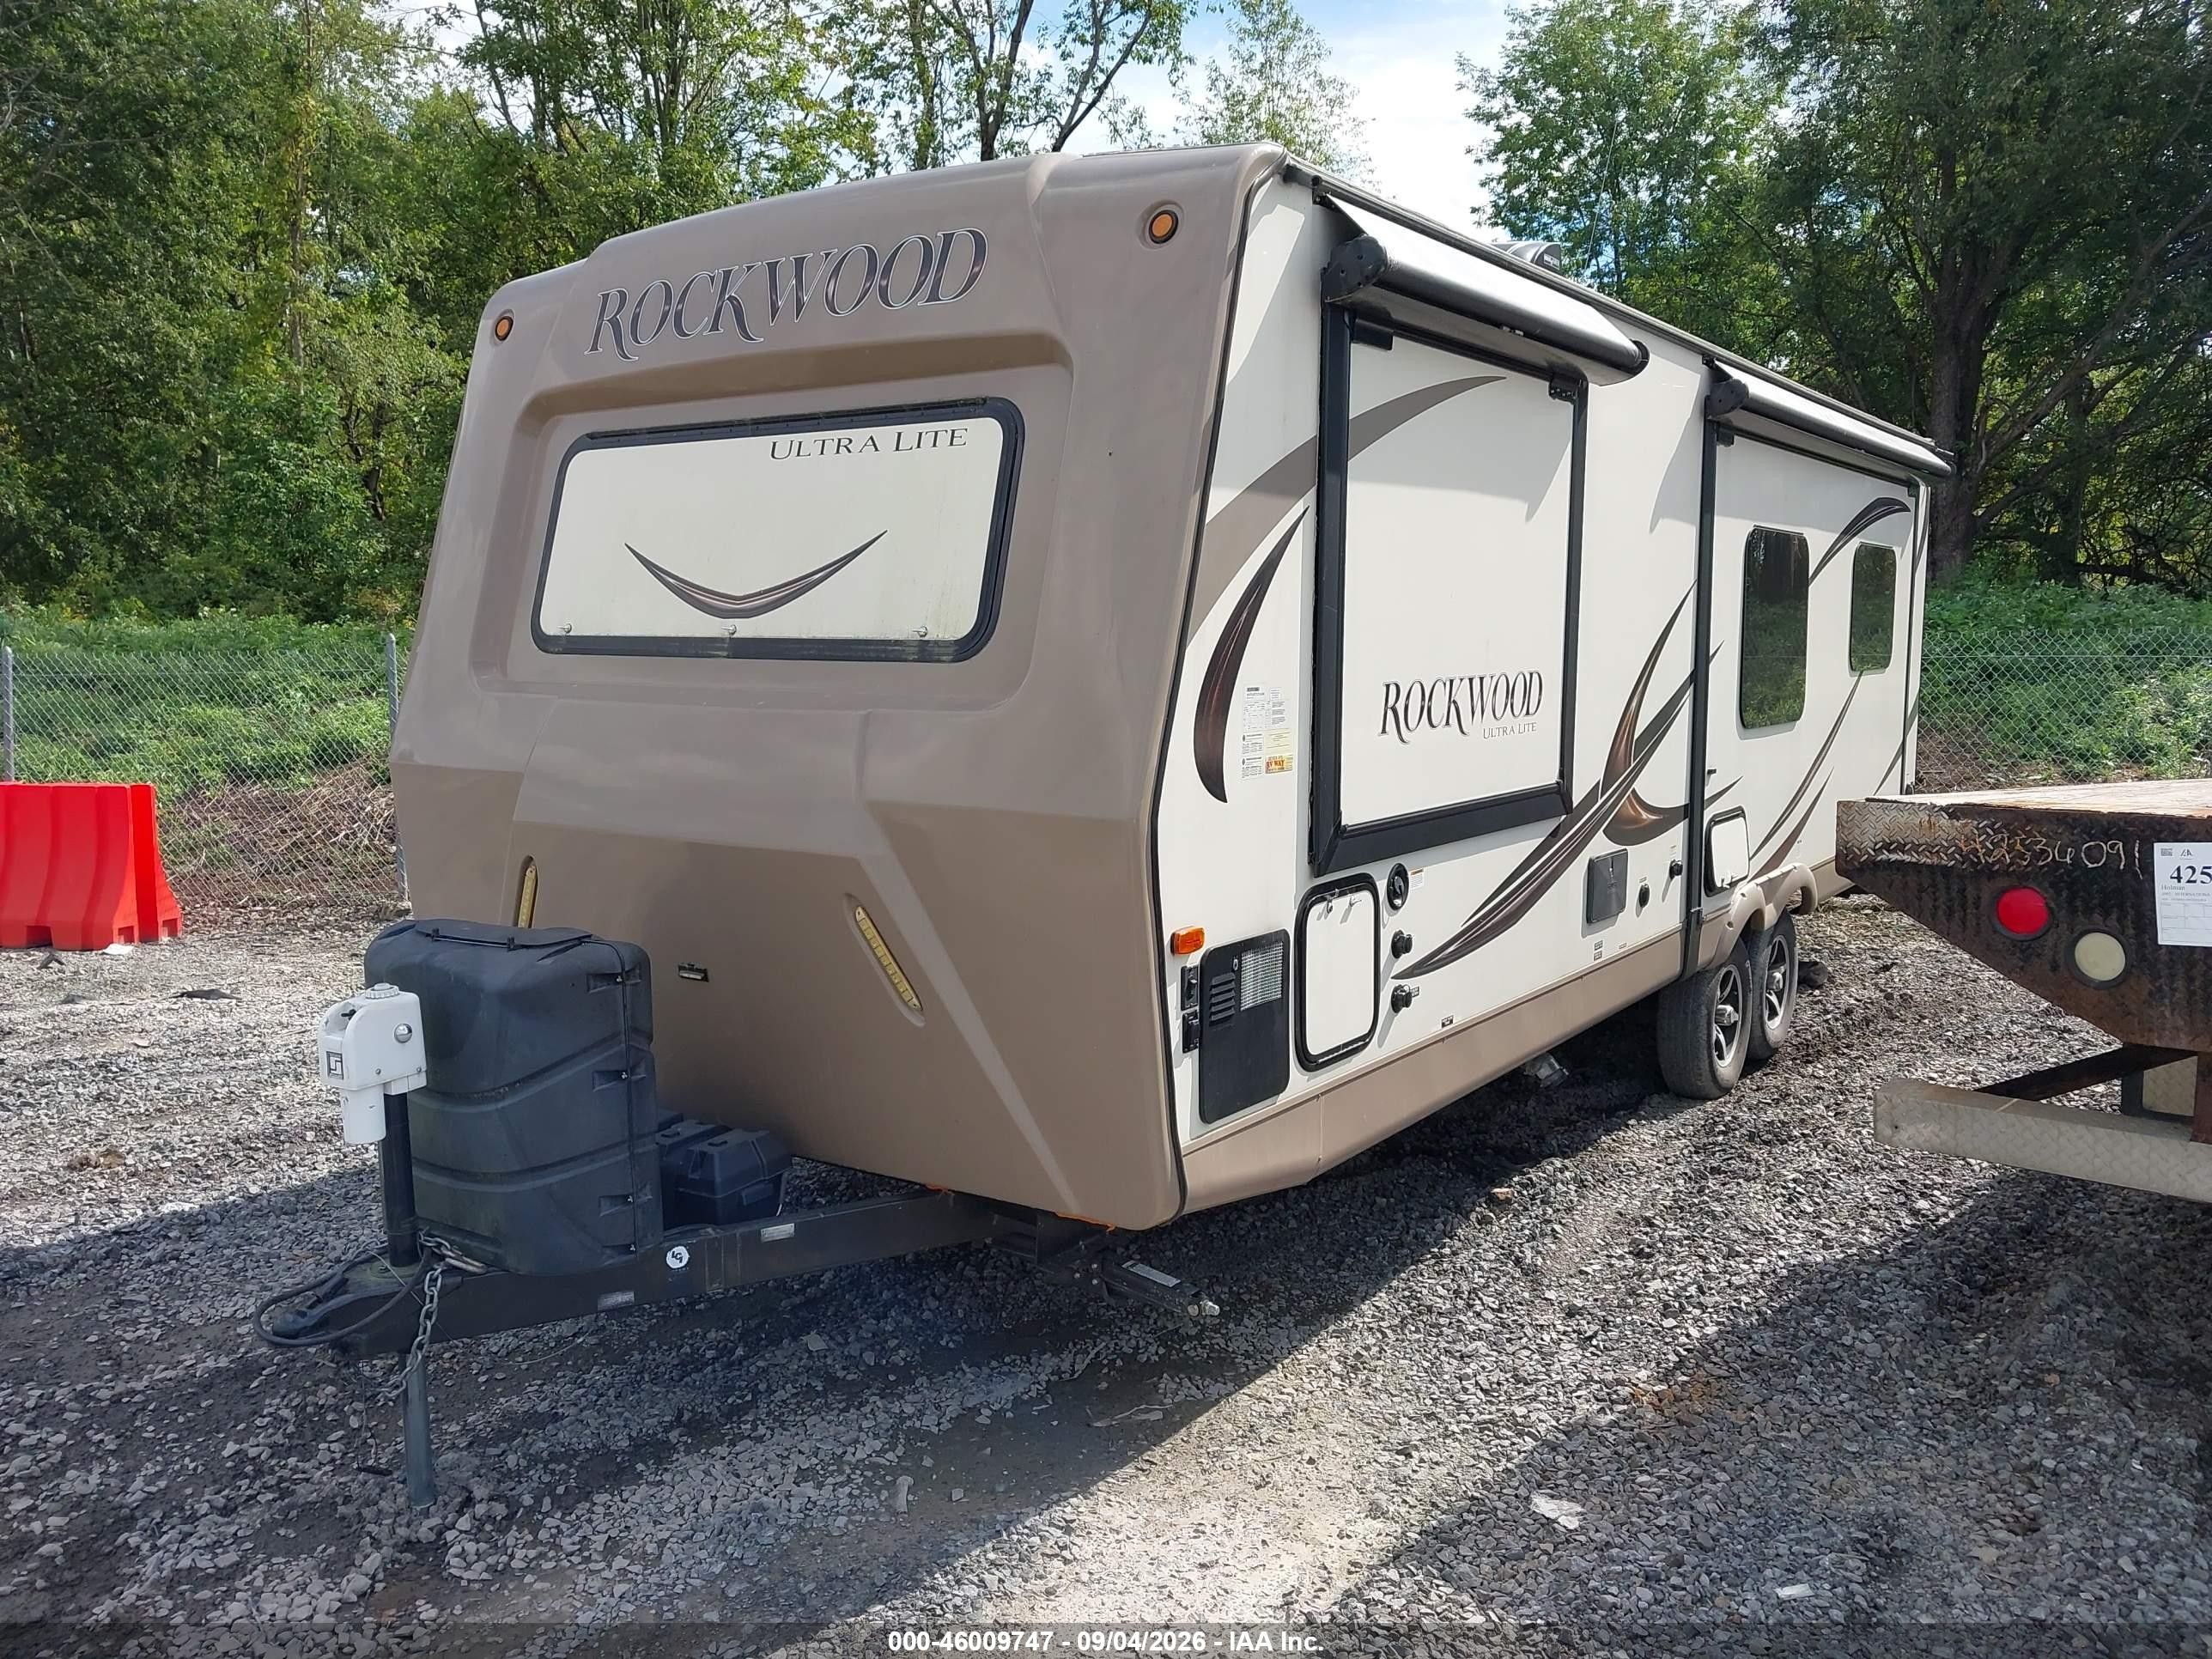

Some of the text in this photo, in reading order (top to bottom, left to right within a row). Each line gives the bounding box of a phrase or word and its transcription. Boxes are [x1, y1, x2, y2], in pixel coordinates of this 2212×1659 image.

[584, 228, 988, 362] ROCKWOOD
[770, 428, 968, 460] ULTRA LITE
[1377, 670, 1544, 744] ROCKWOOD
[1483, 722, 1537, 739] ULTRA LITE
